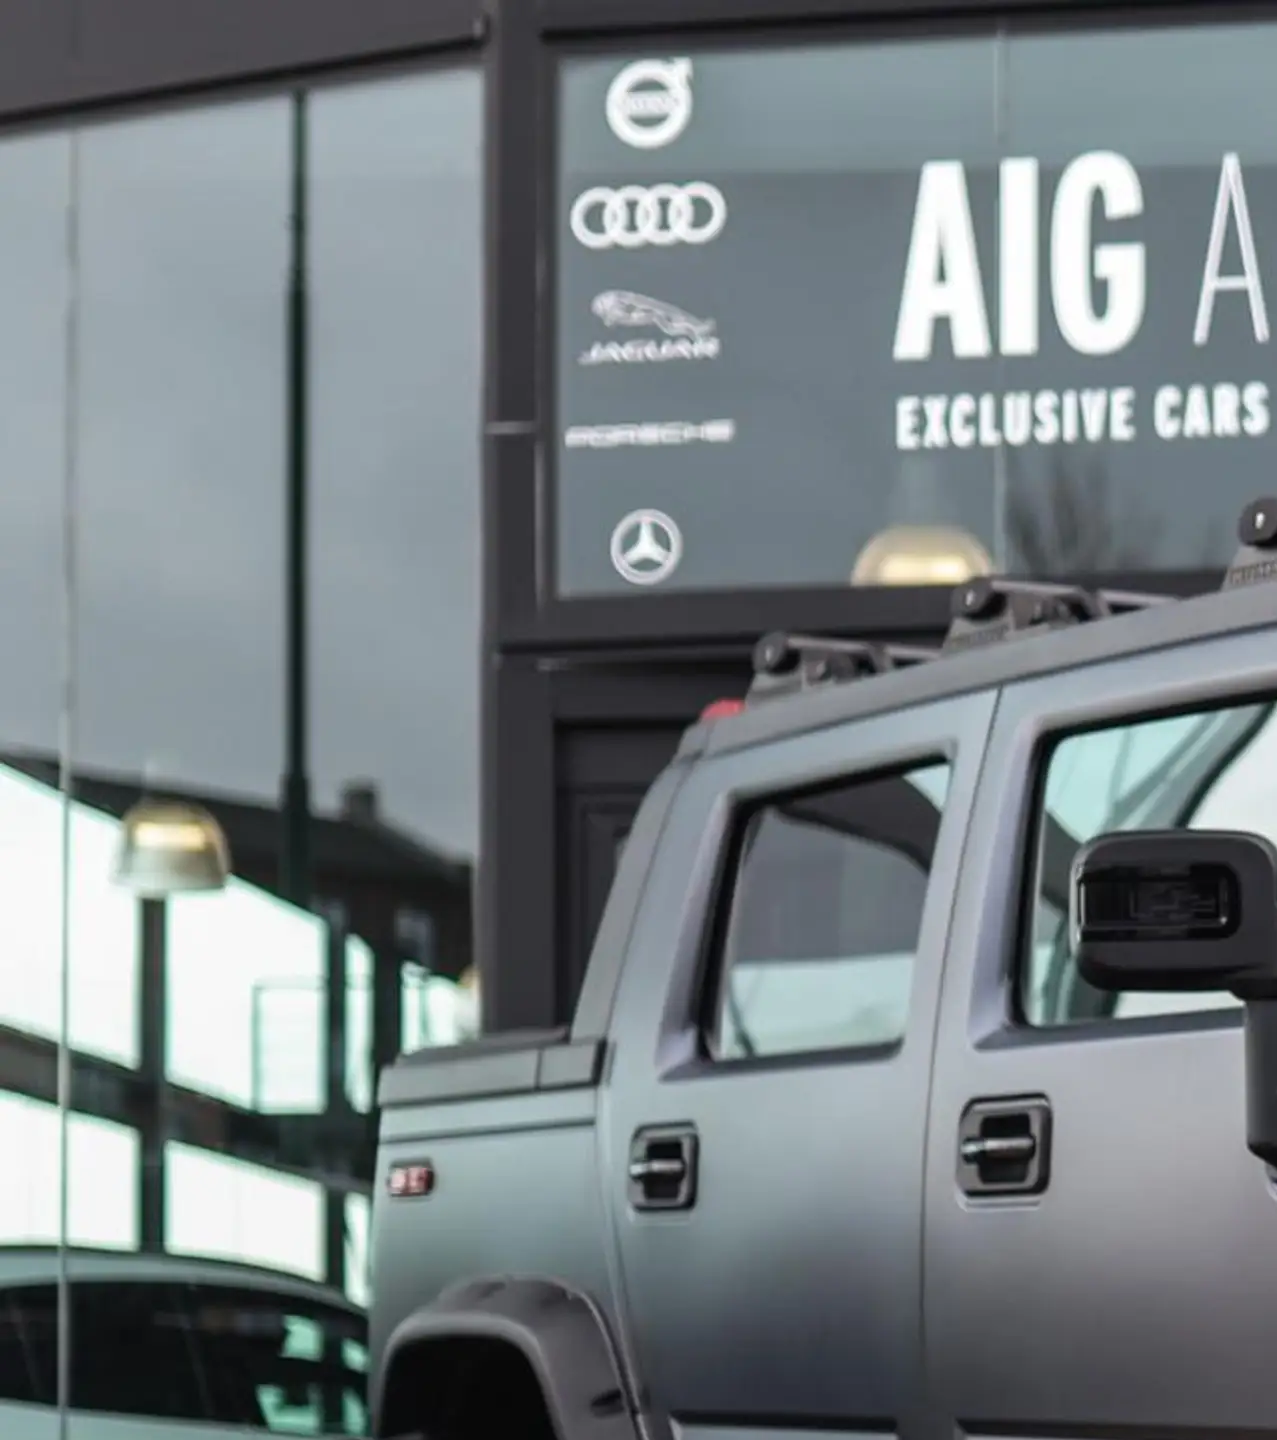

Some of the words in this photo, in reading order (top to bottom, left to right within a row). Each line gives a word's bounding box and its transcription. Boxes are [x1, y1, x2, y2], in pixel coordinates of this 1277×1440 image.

[892, 150, 1146, 361] AIG
[897, 387, 1135, 449] EXCLUSIVE
[1154, 381, 1270, 438] CARS
